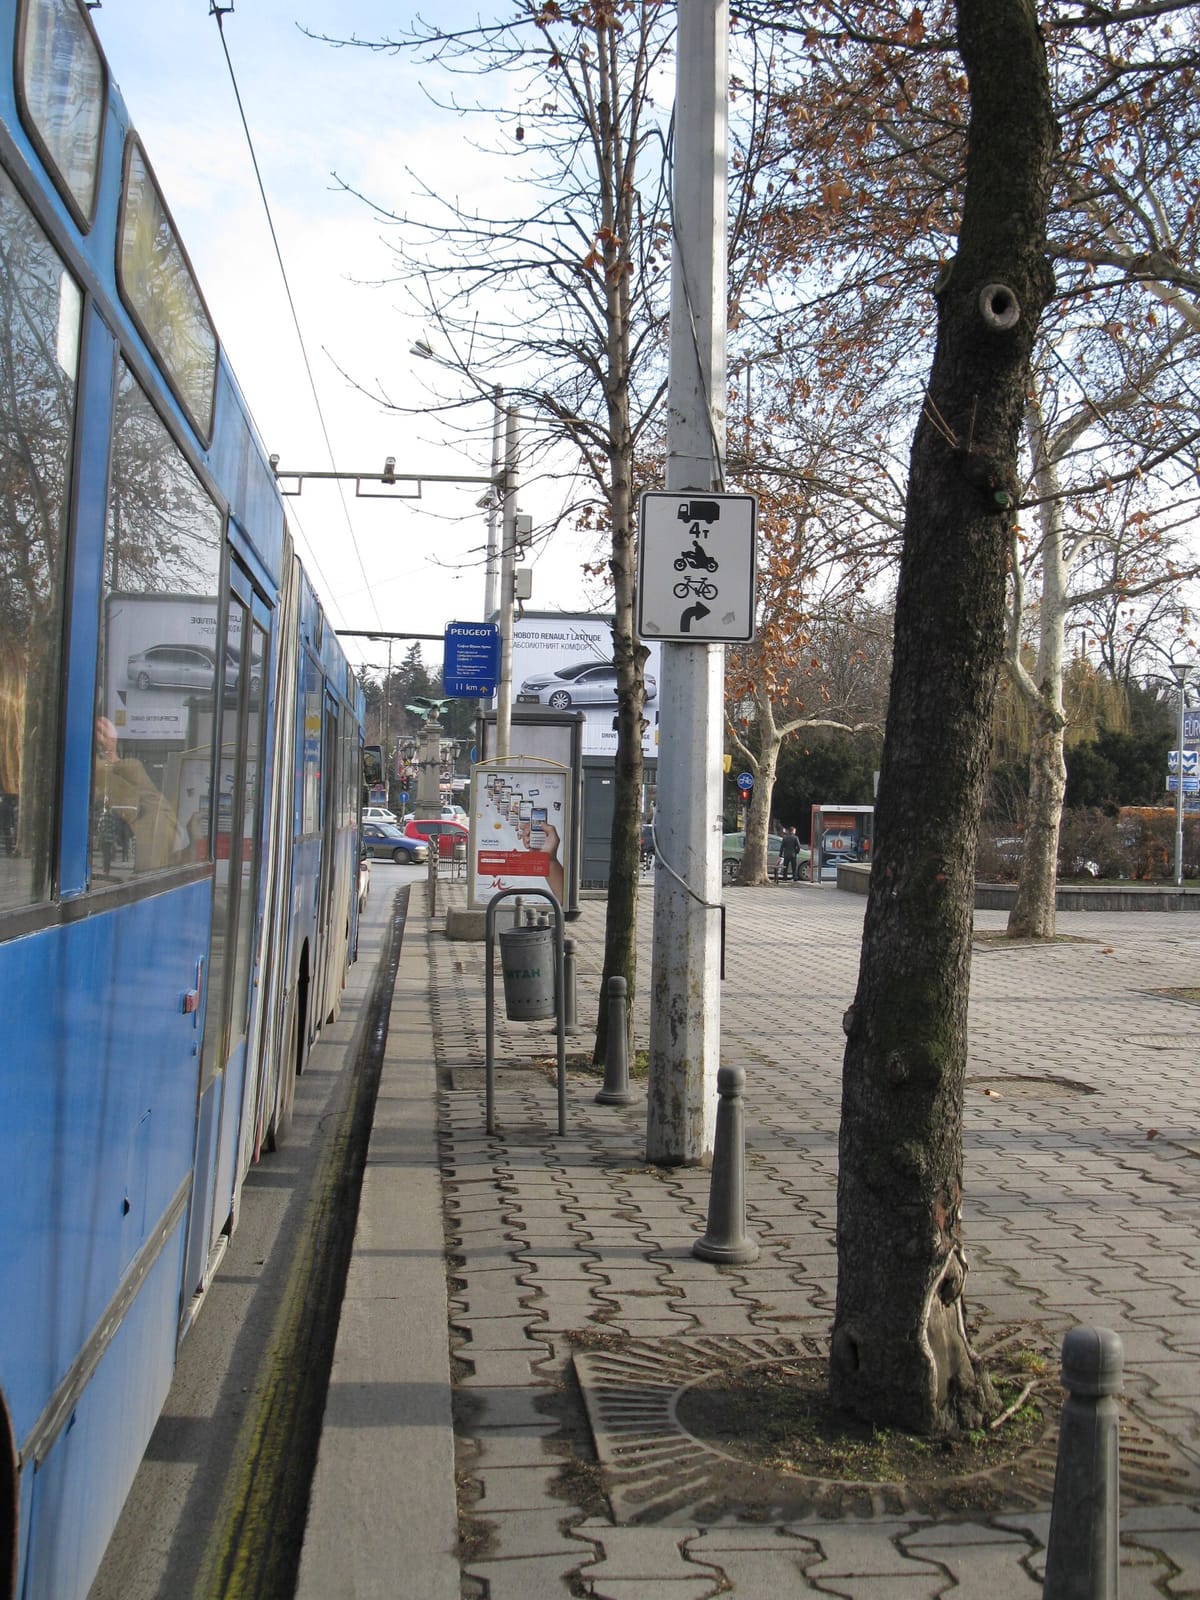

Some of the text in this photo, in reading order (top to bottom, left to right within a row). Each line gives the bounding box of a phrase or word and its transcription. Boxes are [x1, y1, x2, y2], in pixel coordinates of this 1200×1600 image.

[451, 628, 492, 636] PEUGEOT
[541, 632, 570, 640] RENAULT
[571, 633, 601, 641] LATITUDE
[466, 683, 478, 691] km
[831, 839, 844, 849] 10
